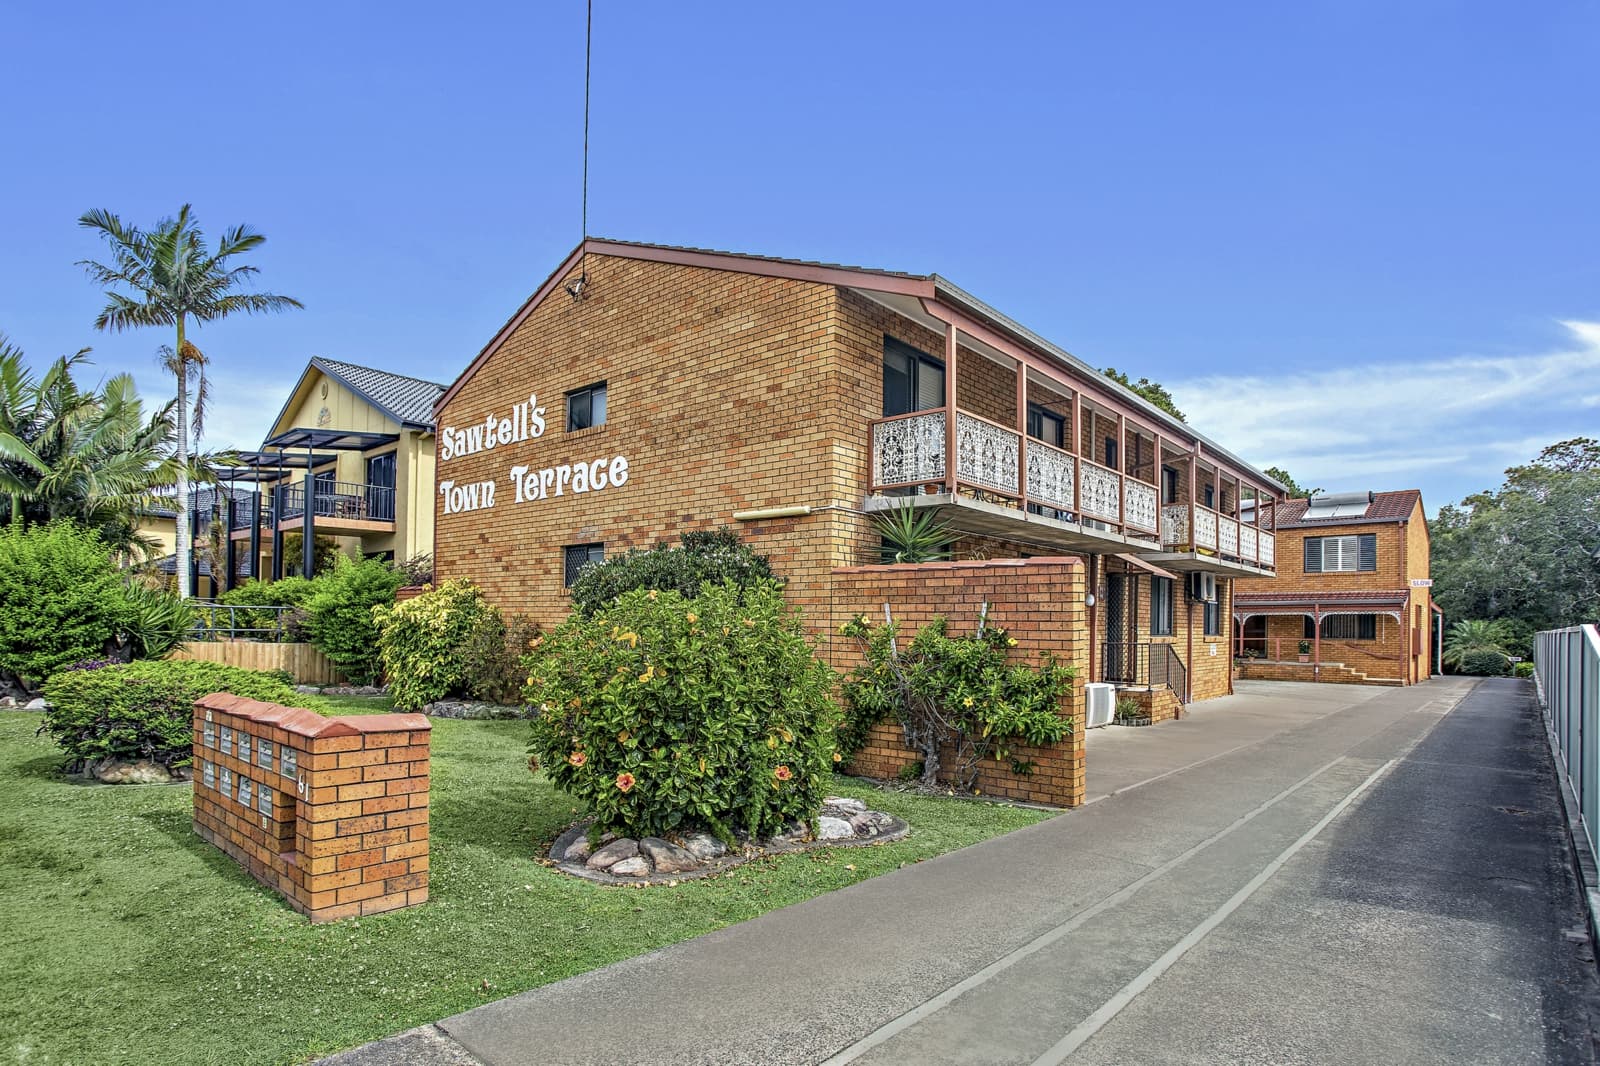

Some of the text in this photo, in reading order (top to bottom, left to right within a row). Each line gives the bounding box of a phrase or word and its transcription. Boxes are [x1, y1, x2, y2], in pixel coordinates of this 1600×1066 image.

[441, 393, 546, 461] Sawtell's
[439, 455, 629, 515] Town Terrace
[298, 774, 309, 802] 61
